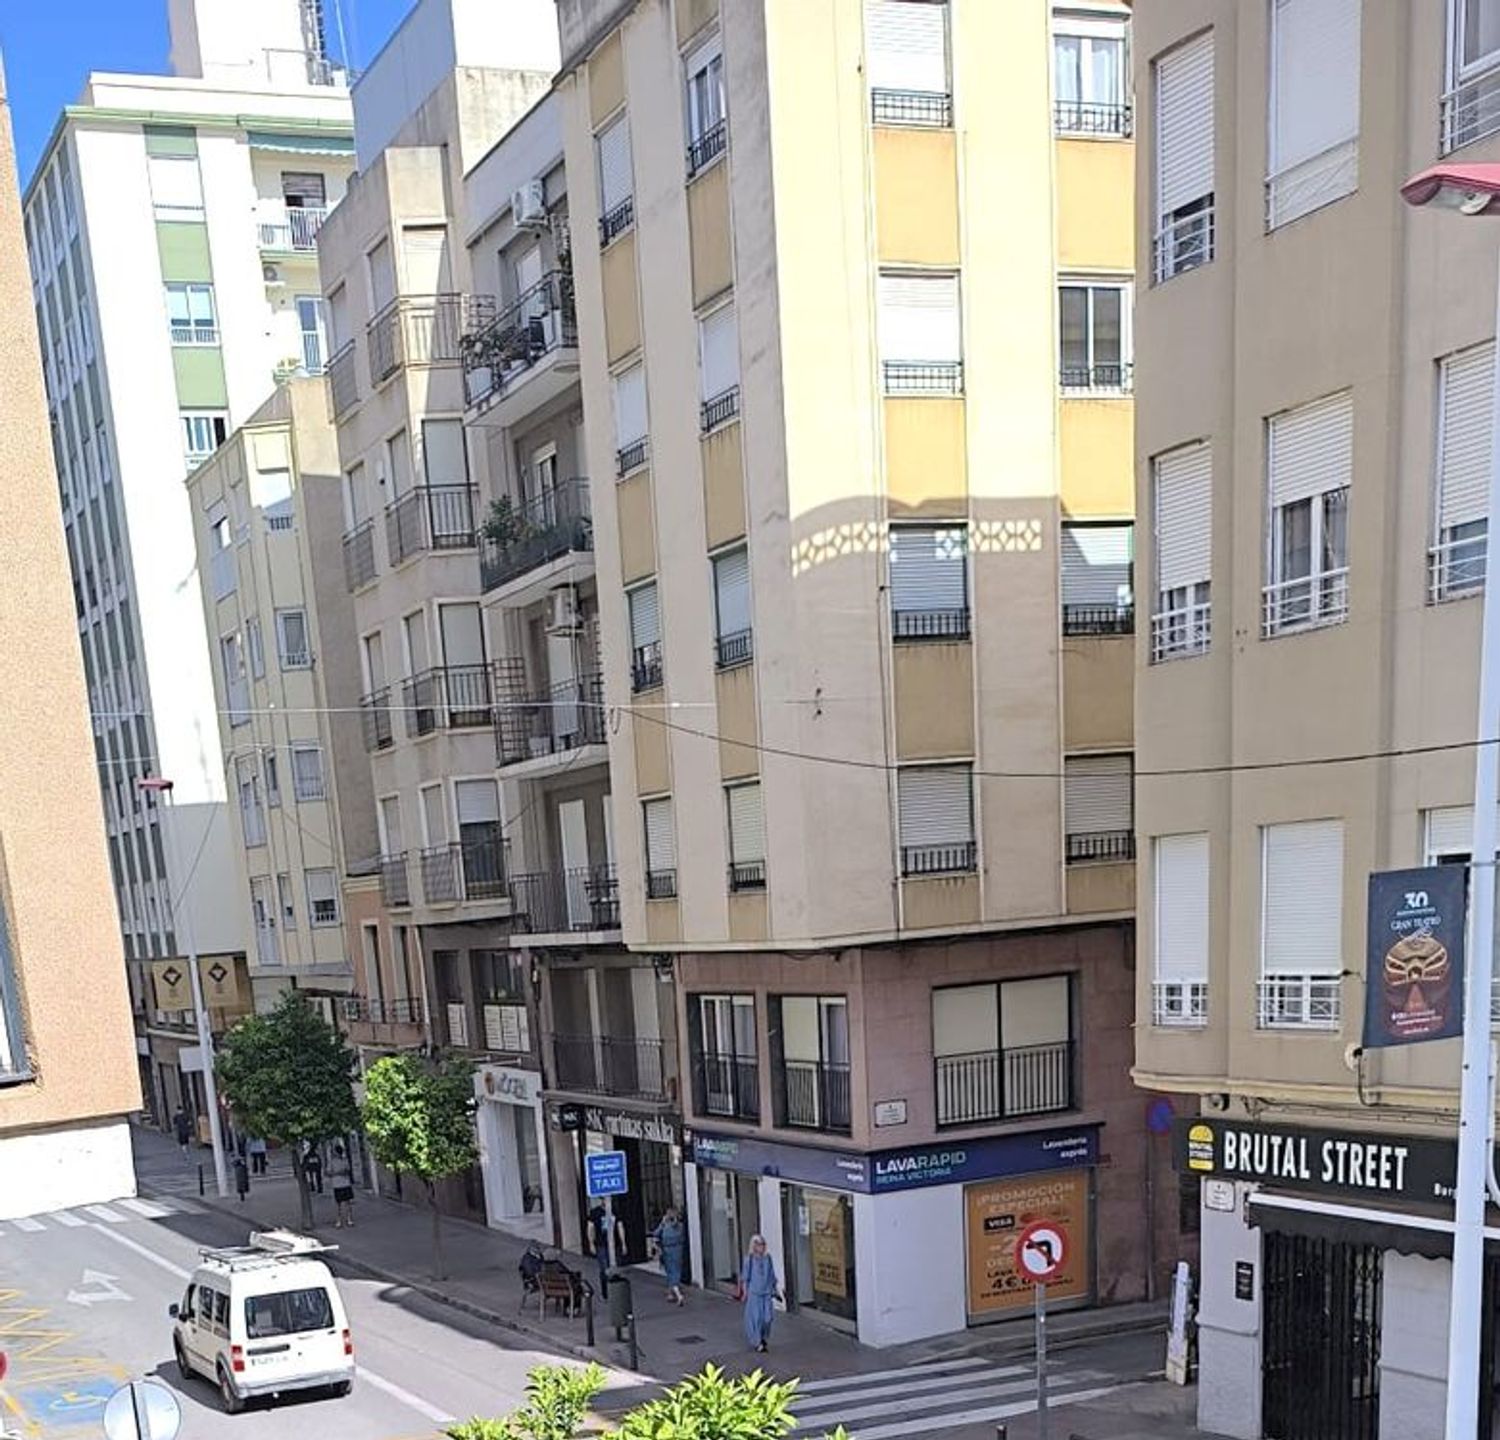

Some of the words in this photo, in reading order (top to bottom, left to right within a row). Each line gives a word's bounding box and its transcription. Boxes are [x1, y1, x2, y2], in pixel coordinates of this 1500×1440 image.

[875, 1151, 966, 1175] LAVARAPID
[1224, 1131, 1310, 1179] BRUTAL
[1321, 1140, 1407, 1190] STREET
[594, 1177, 621, 1190] TAXI
